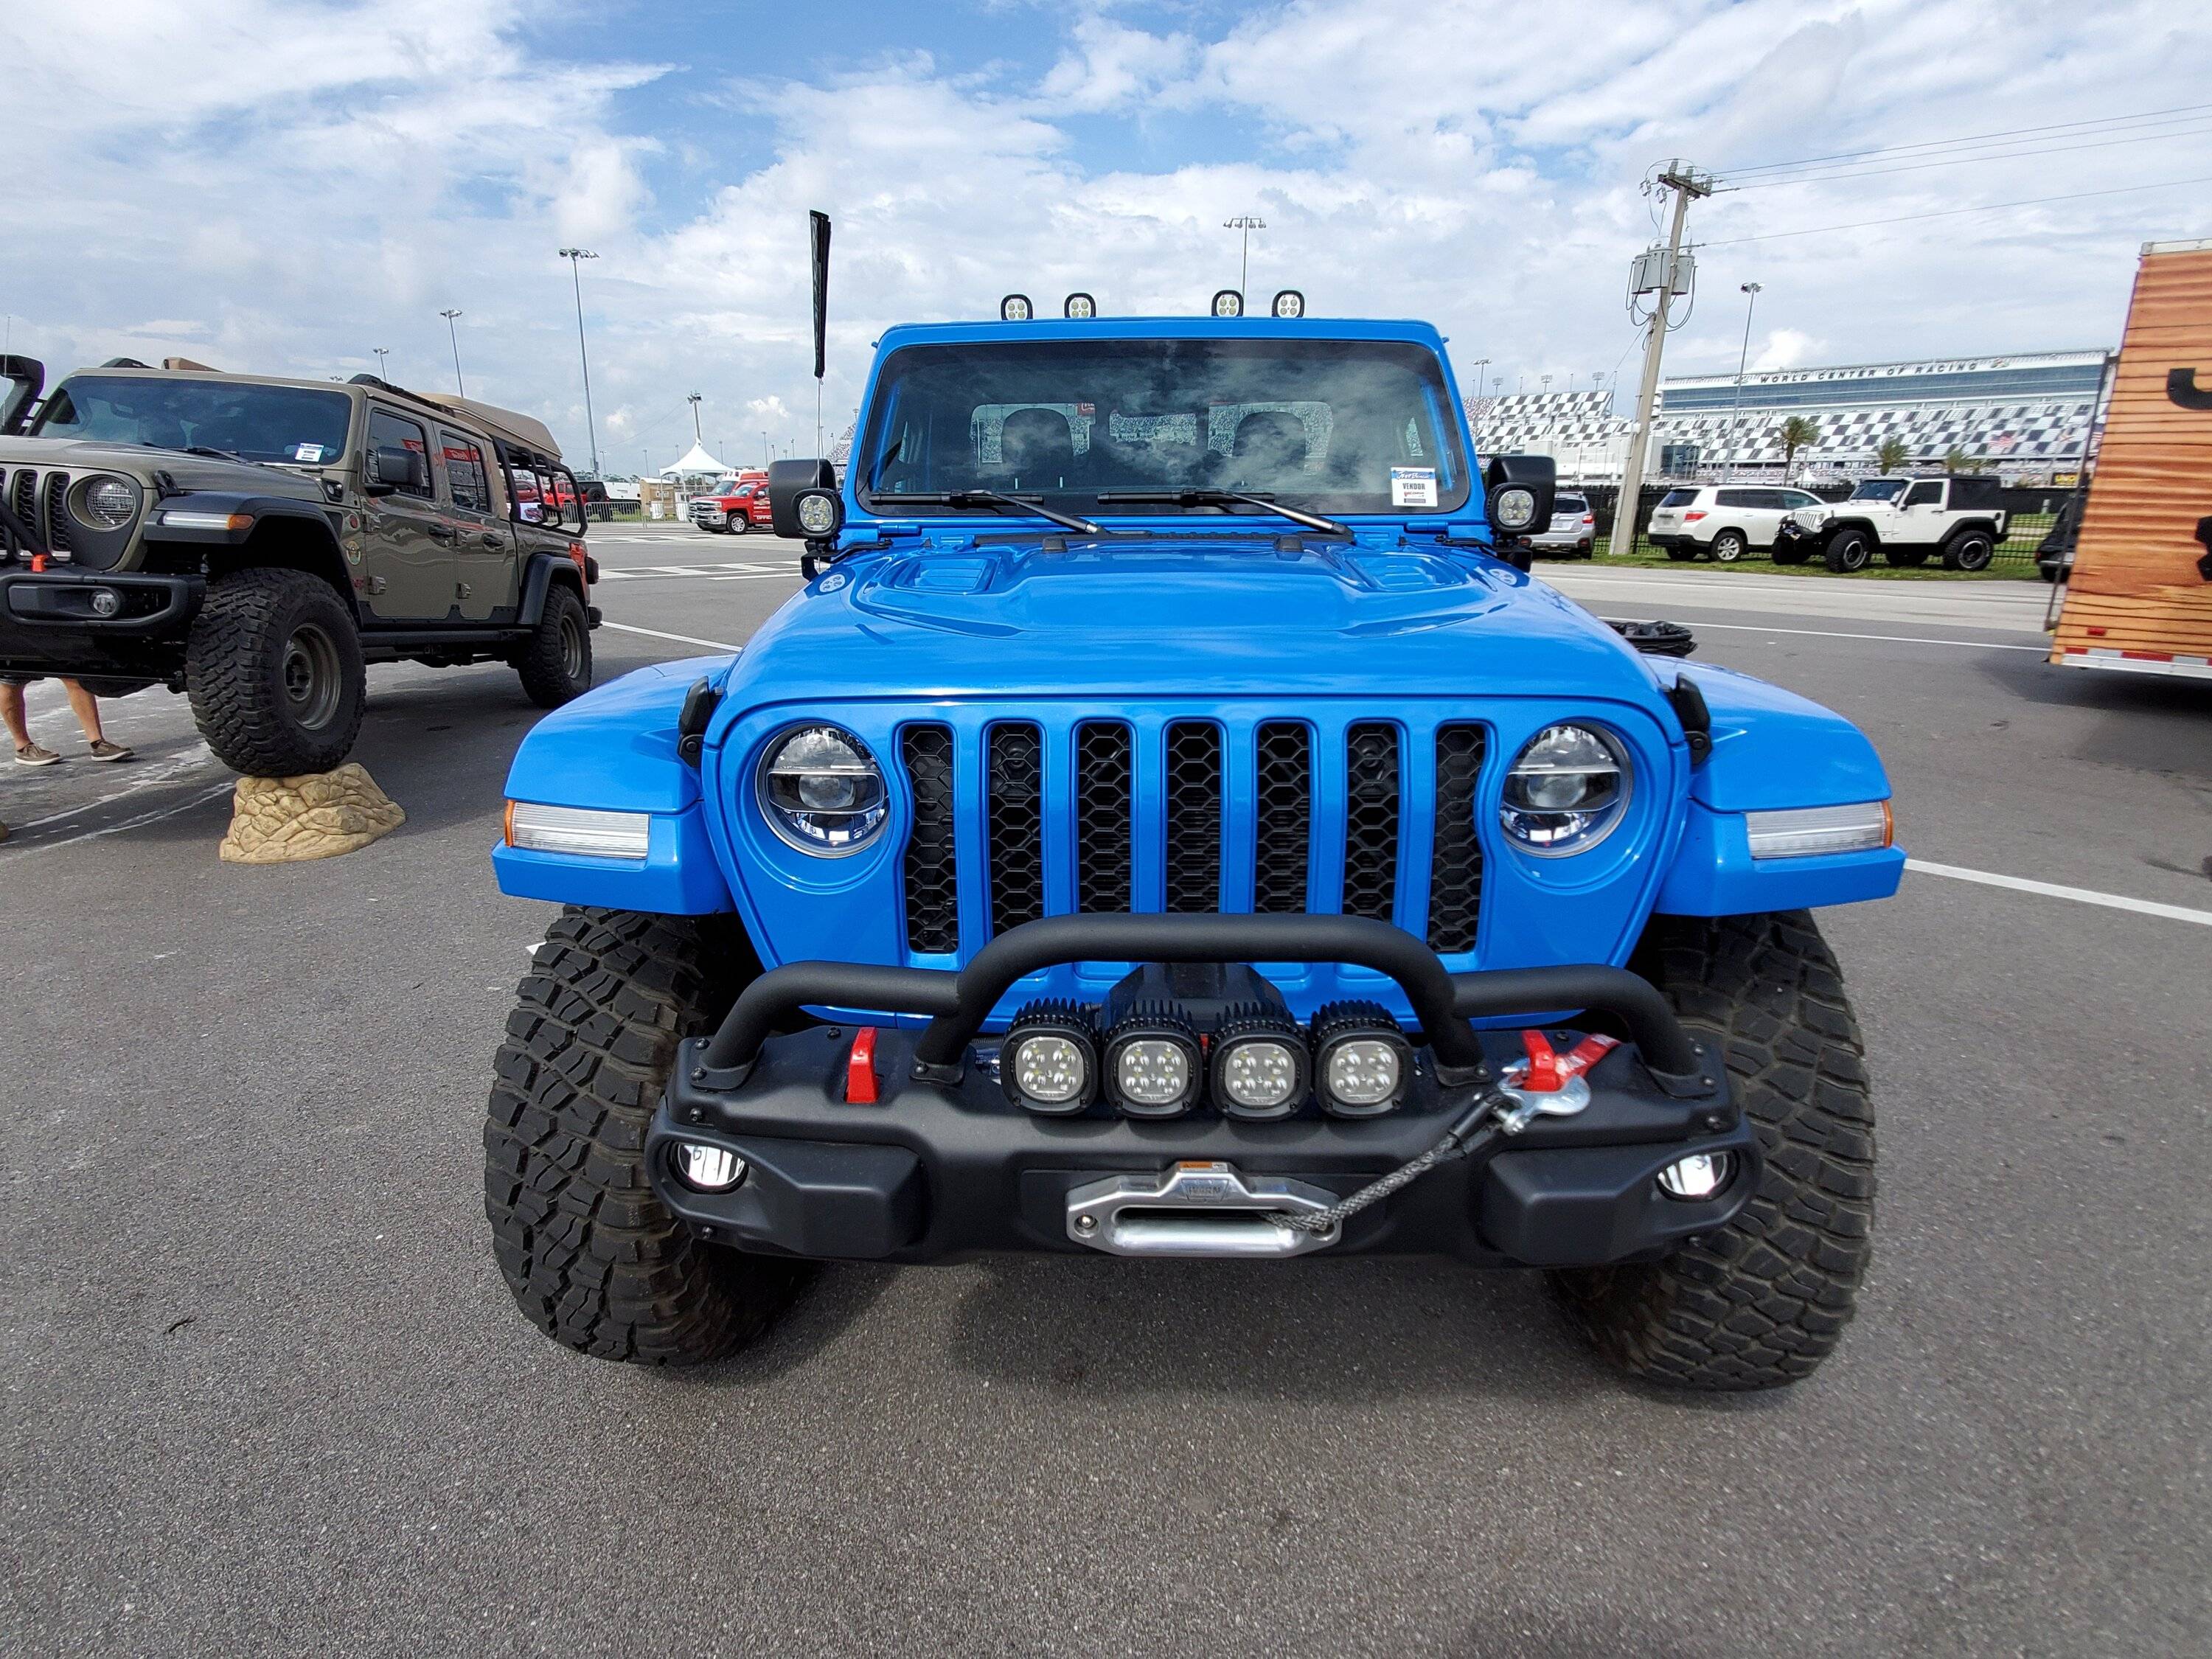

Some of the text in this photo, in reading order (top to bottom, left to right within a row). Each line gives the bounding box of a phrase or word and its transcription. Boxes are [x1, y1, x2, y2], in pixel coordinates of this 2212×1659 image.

[1760, 363, 1977, 383] WORLD CENTER OF RACING
